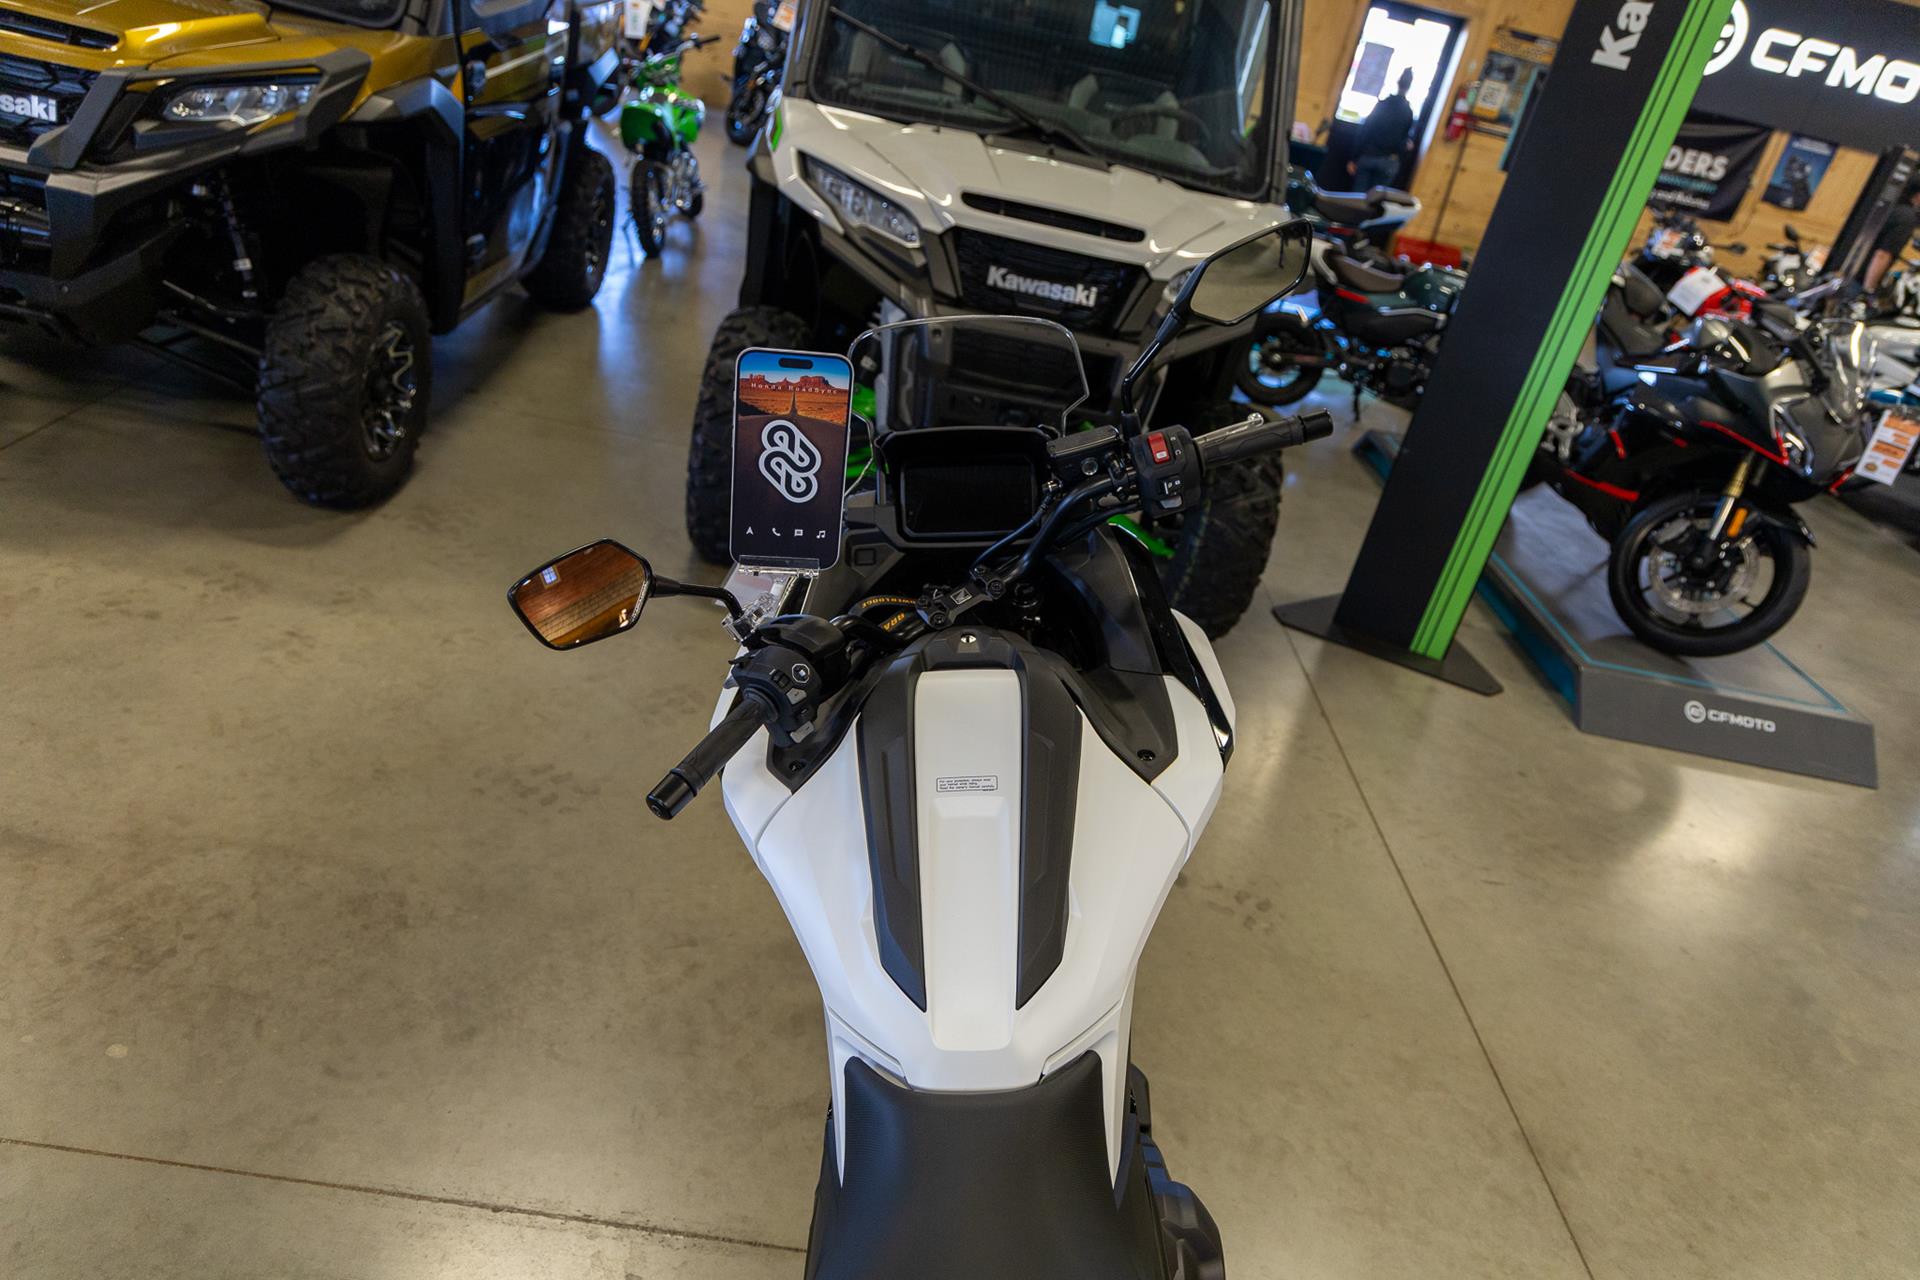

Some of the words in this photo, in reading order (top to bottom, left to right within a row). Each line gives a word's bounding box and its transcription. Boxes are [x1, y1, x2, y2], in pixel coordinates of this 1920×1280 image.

[1590, 0, 1655, 72] Ka
[1750, 28, 1920, 104] CFMO
[0, 94, 57, 122] saki
[1663, 145, 1729, 181] DERS
[986, 265, 1098, 308] Kawasaki
[750, 382, 782, 391] Honda
[788, 384, 838, 395] RoadSync
[1707, 709, 1776, 733] CFMOTO
